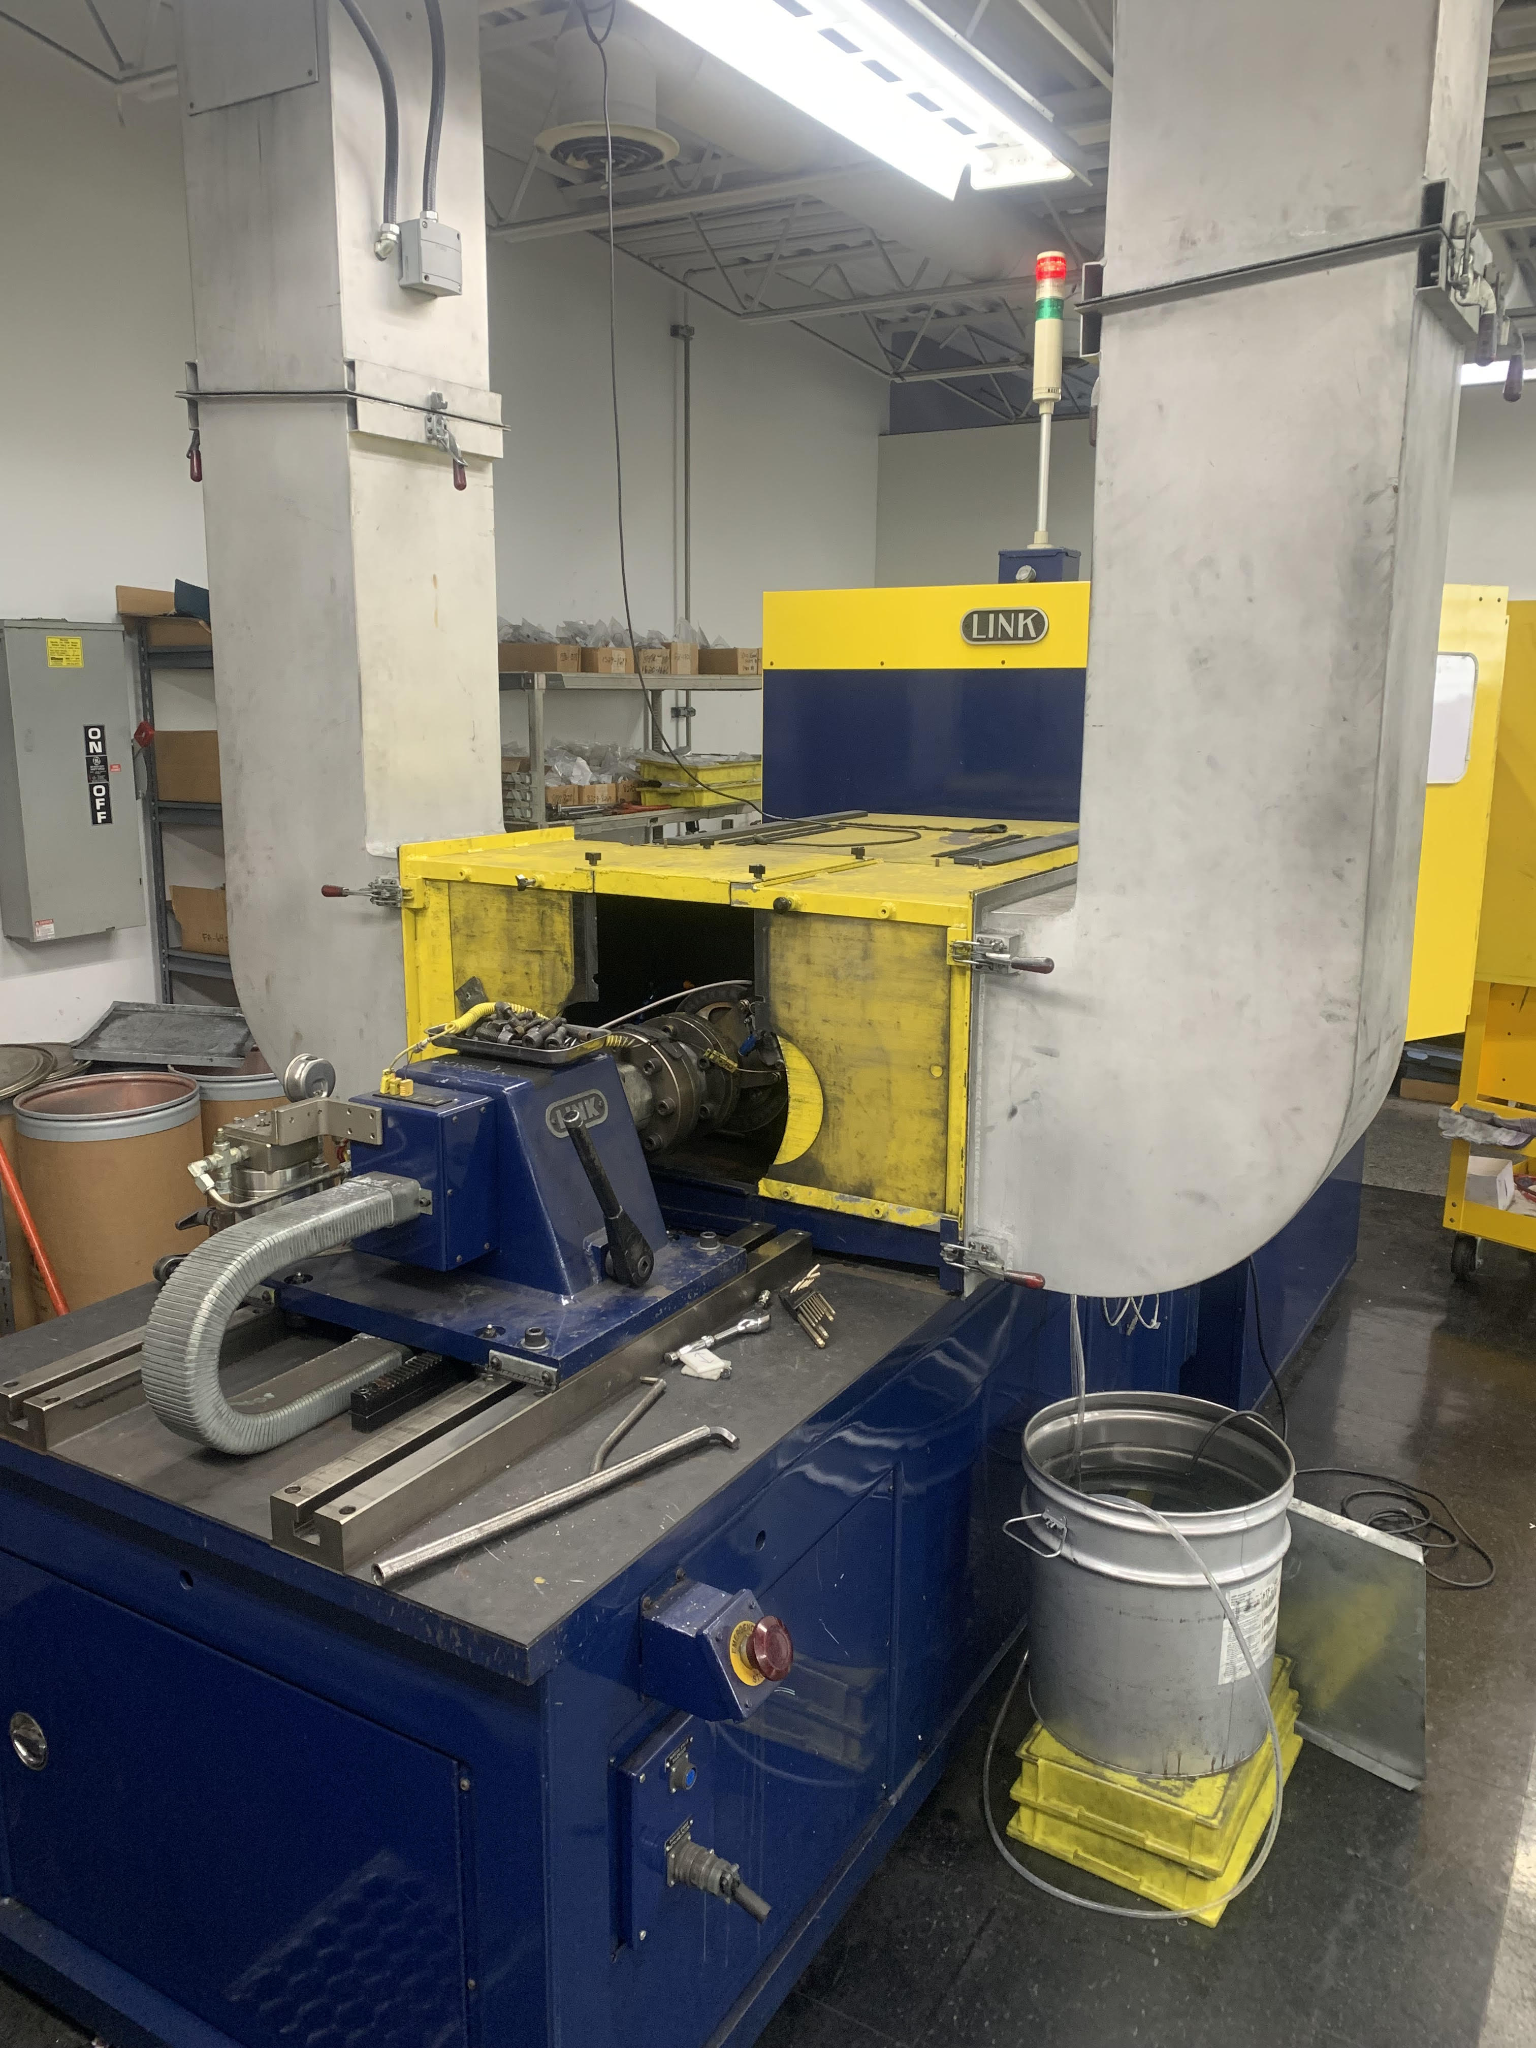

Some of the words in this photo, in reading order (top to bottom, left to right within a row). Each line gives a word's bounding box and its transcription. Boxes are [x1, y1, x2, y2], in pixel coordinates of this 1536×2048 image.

[972, 612, 1038, 638] LINK
[88, 727, 103, 754] ON
[92, 784, 107, 824] OFF
